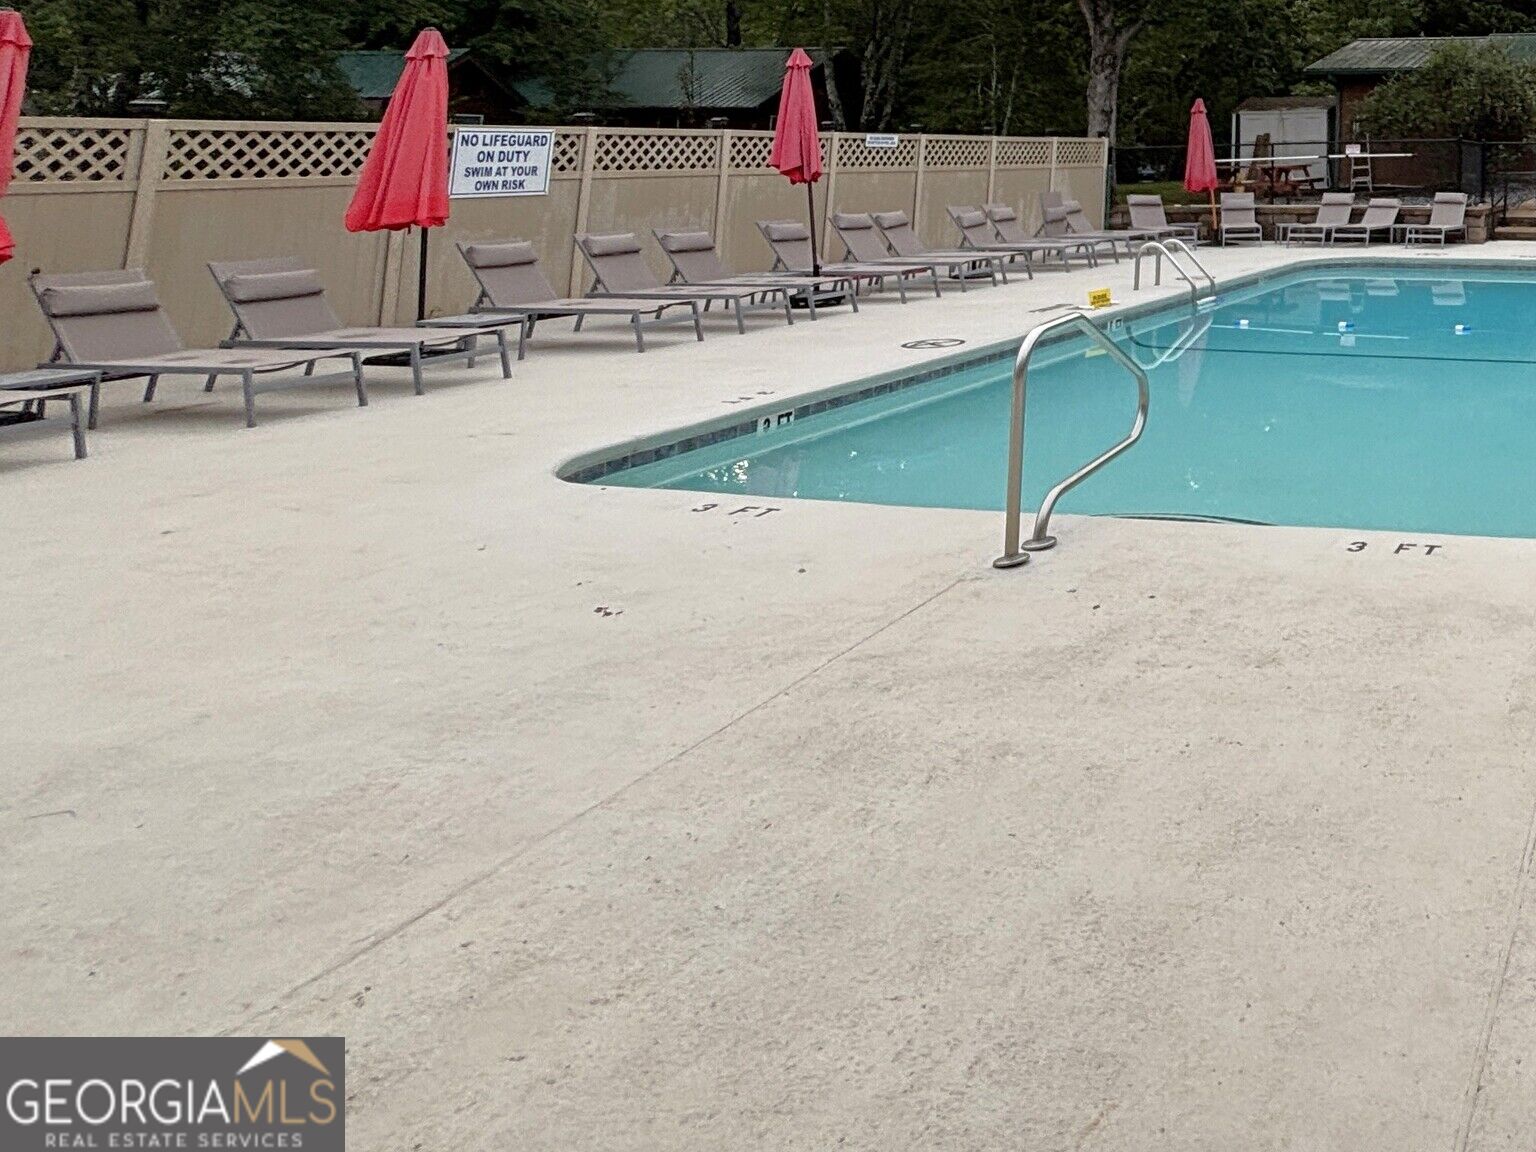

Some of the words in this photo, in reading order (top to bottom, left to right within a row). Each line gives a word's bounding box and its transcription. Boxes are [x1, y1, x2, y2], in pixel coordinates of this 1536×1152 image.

[460, 134, 479, 147] NO
[482, 134, 548, 147] LIFEGUARD
[477, 150, 495, 163] ON
[498, 150, 531, 163] DUTY
[464, 166, 493, 178] SWIM
[494, 166, 509, 177] AT
[511, 165, 538, 177] YOUR
[474, 181, 499, 191] OWN
[501, 179, 526, 190] RISK
[1347, 541, 1368, 552] 3
[1393, 543, 1442, 555] FT
